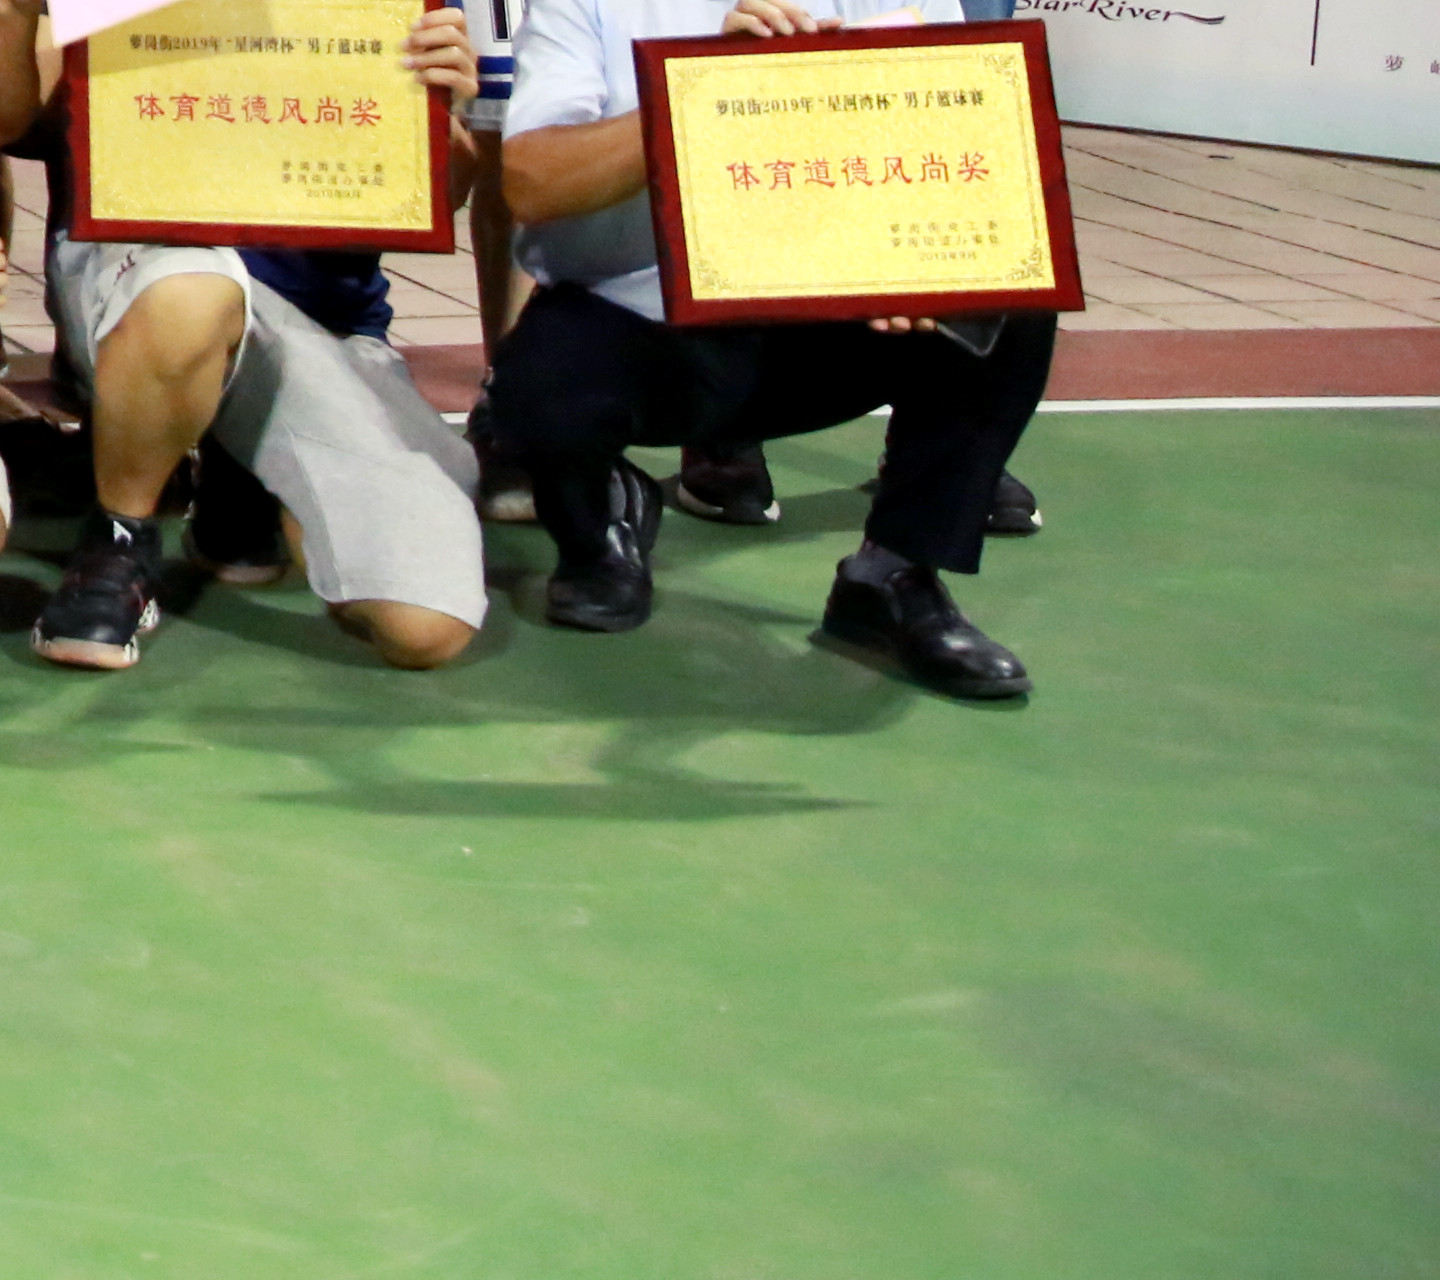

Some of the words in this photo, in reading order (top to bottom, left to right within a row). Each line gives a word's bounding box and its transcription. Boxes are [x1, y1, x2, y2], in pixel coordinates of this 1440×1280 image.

[133, 92, 382, 128] 体育道德风尚奖
[726, 152, 992, 192] 体育道德风尚奖
